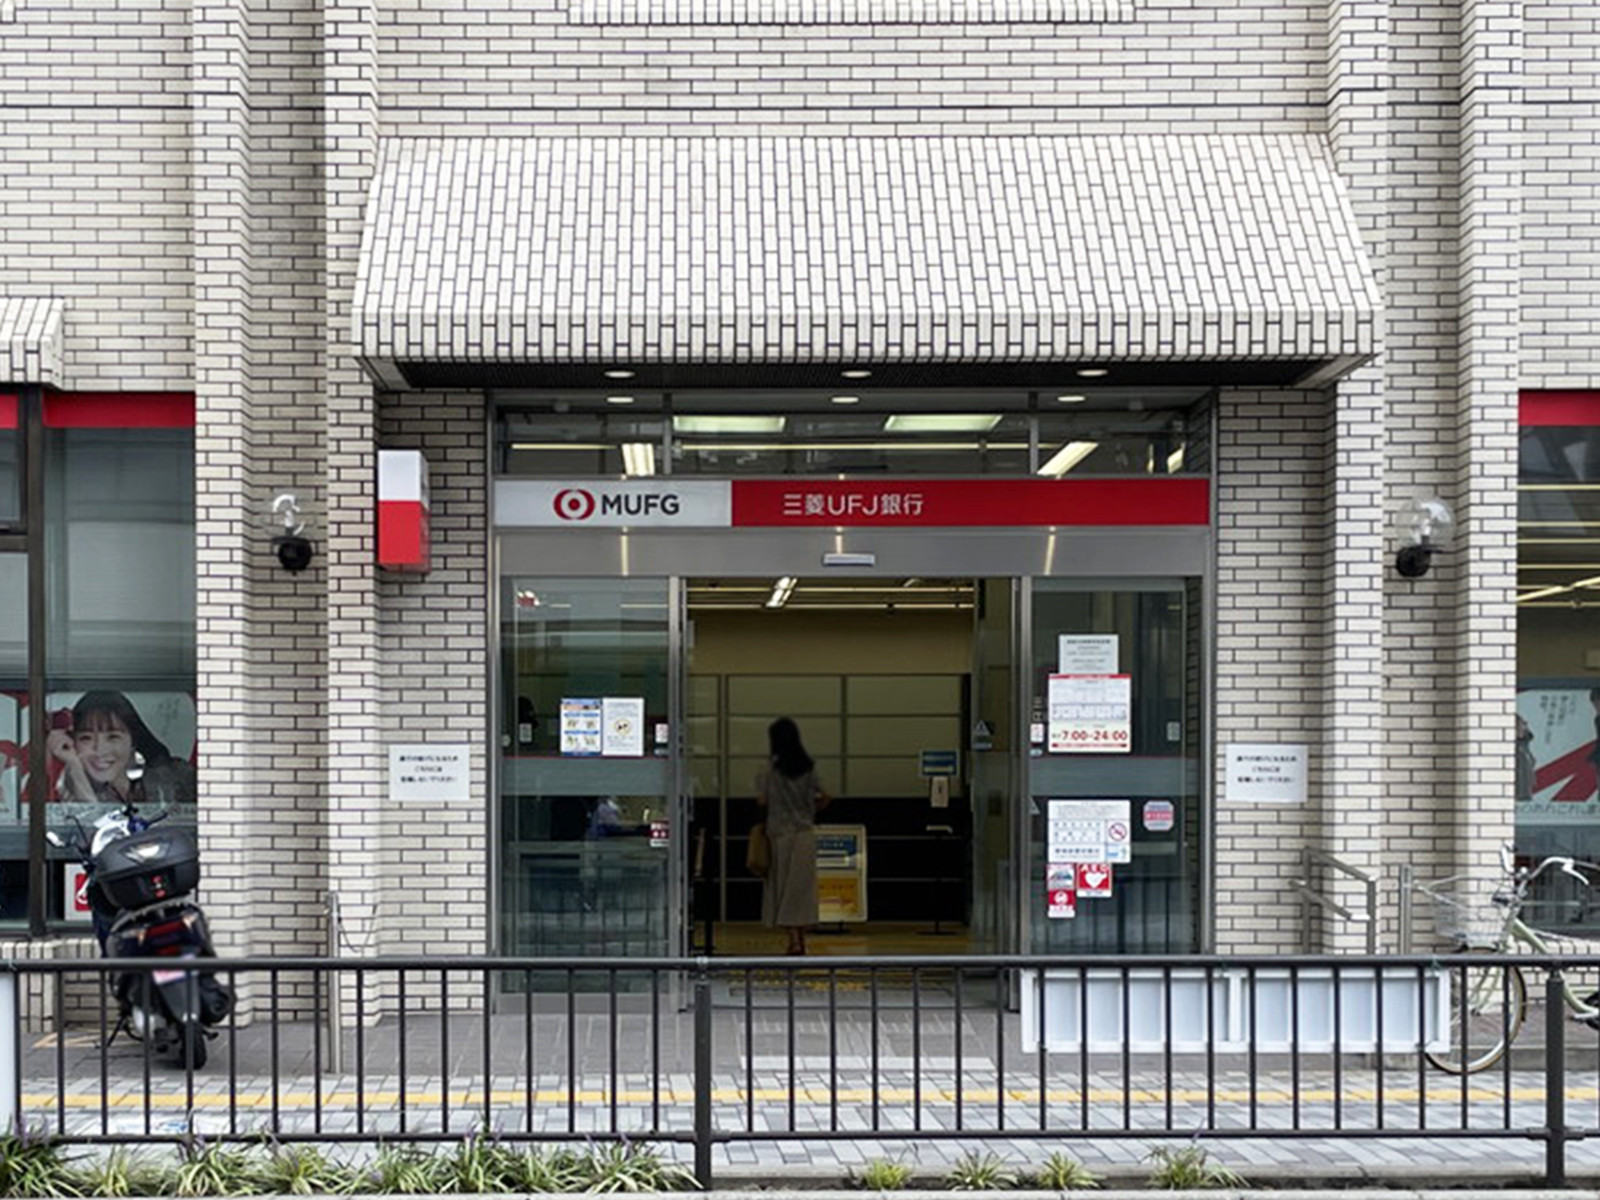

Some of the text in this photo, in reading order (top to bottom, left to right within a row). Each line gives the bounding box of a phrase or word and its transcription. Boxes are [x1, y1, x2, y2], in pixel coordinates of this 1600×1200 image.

[602, 494, 680, 515] MUFG
[783, 493, 923, 516] 三菱UFJ銀行
